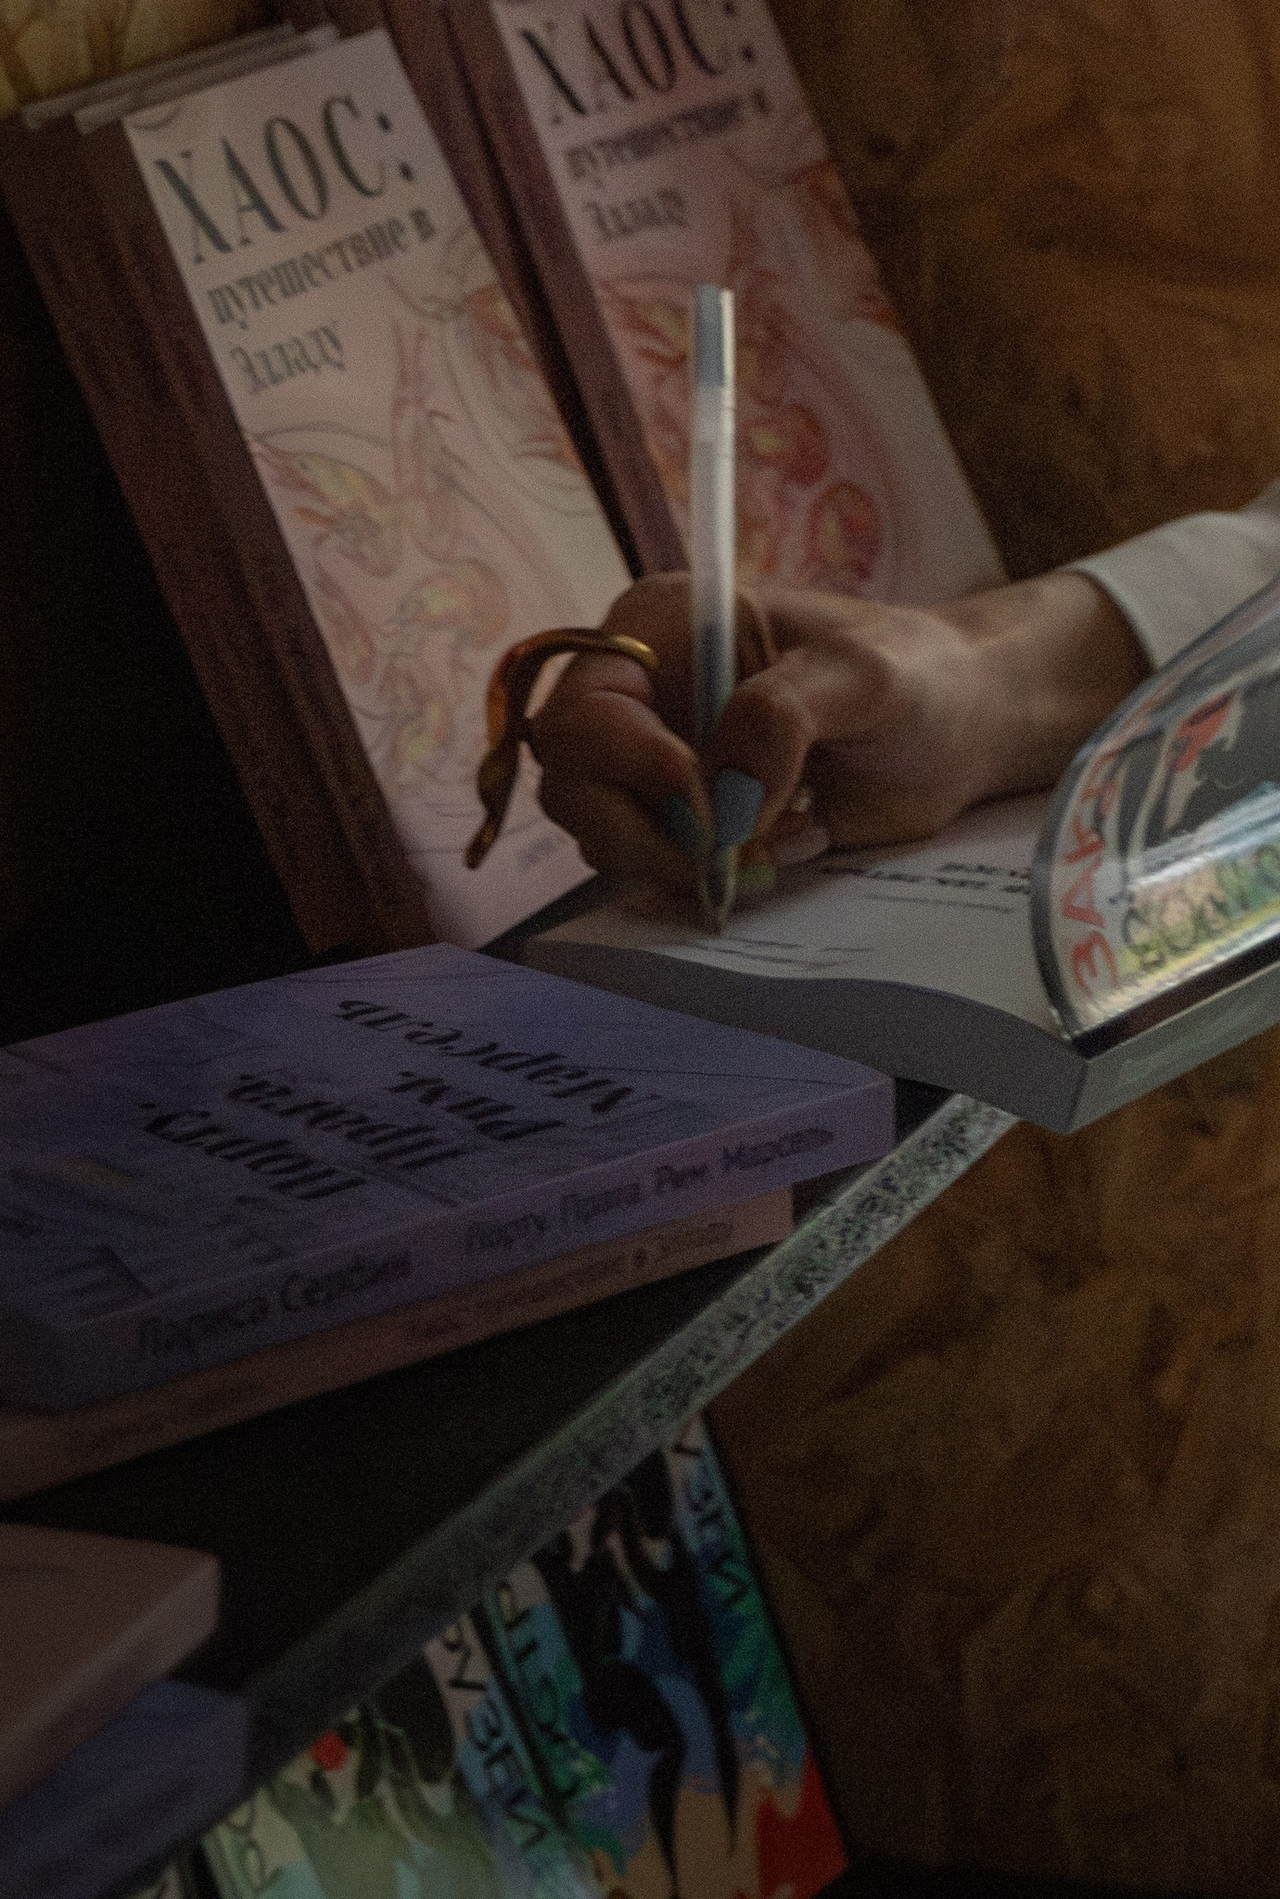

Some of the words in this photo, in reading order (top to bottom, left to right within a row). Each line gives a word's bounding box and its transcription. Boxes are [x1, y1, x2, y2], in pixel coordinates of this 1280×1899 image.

[153, 93, 416, 264] ХАОС:
[207, 218, 409, 330] путешествие
[409, 207, 436, 243] в
[336, 998, 663, 1116] Марсель
